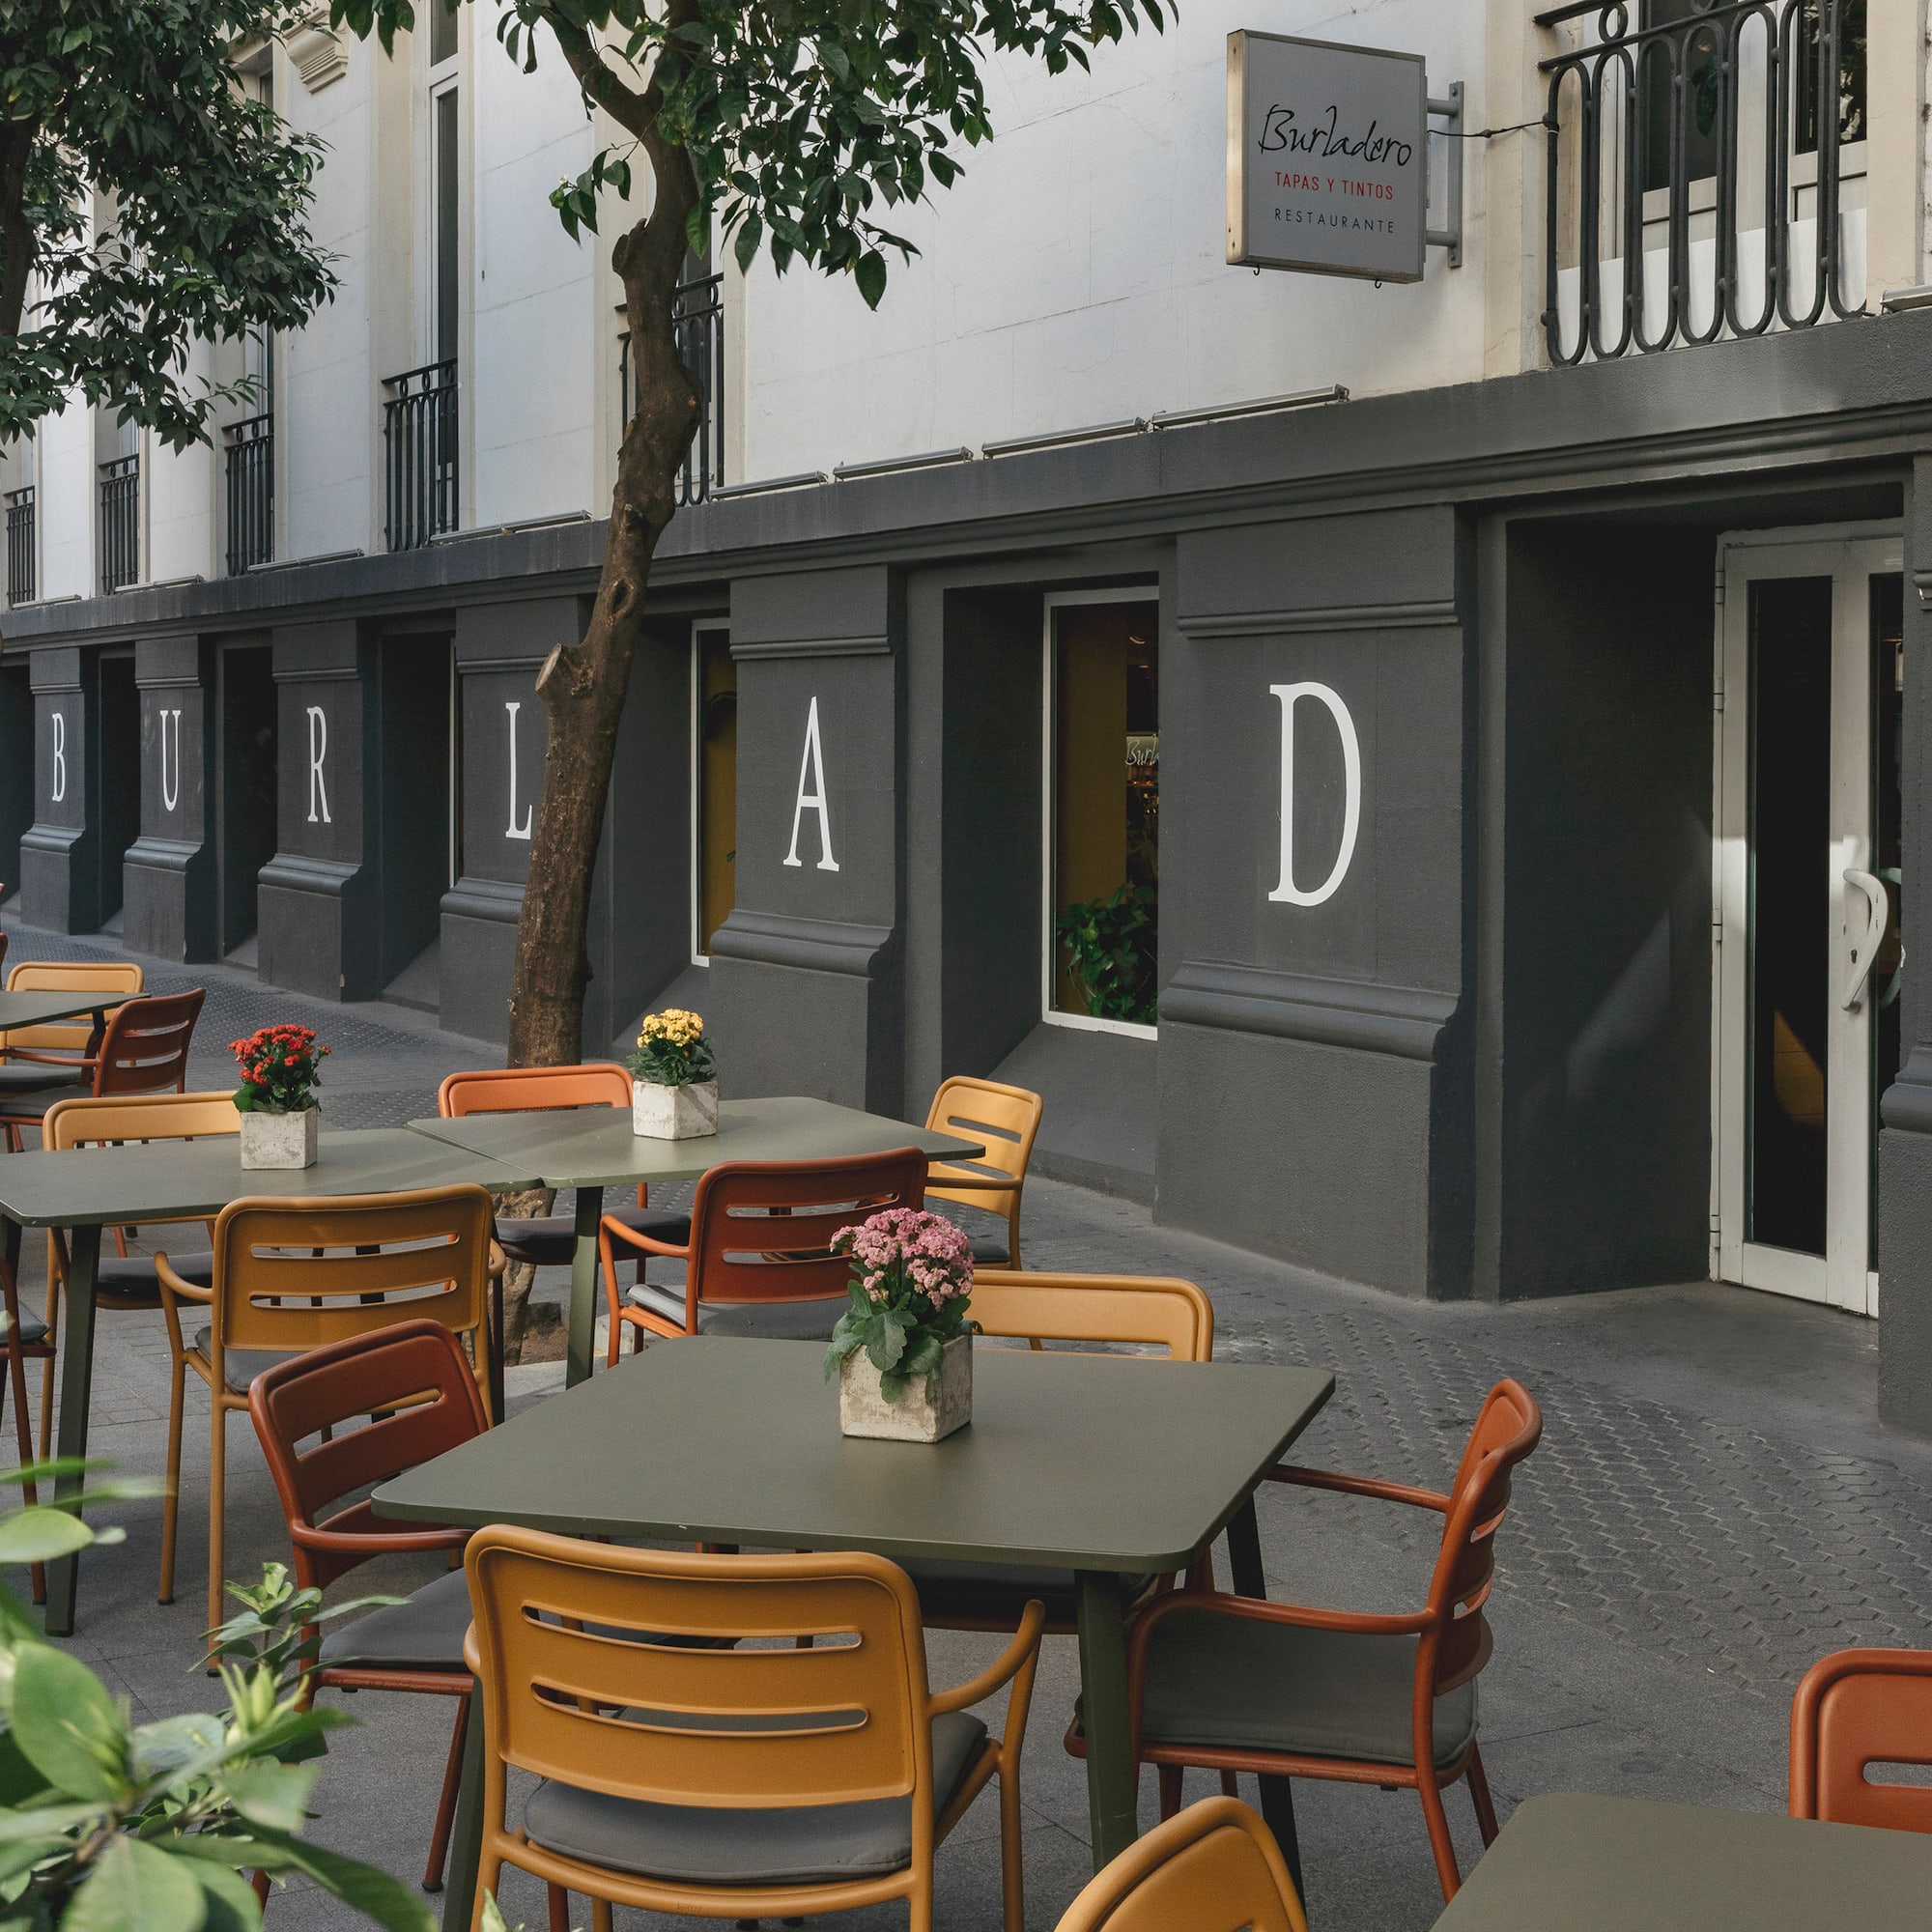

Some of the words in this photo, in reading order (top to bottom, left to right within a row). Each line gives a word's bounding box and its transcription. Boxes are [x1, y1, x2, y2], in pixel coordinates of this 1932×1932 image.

[1258, 103, 1412, 166] Burladero
[1274, 171, 1321, 191] TAPAS
[1326, 178, 1336, 193] Y
[1342, 180, 1394, 200] TINTOS
[1274, 208, 1395, 234] RESTAURANTE
